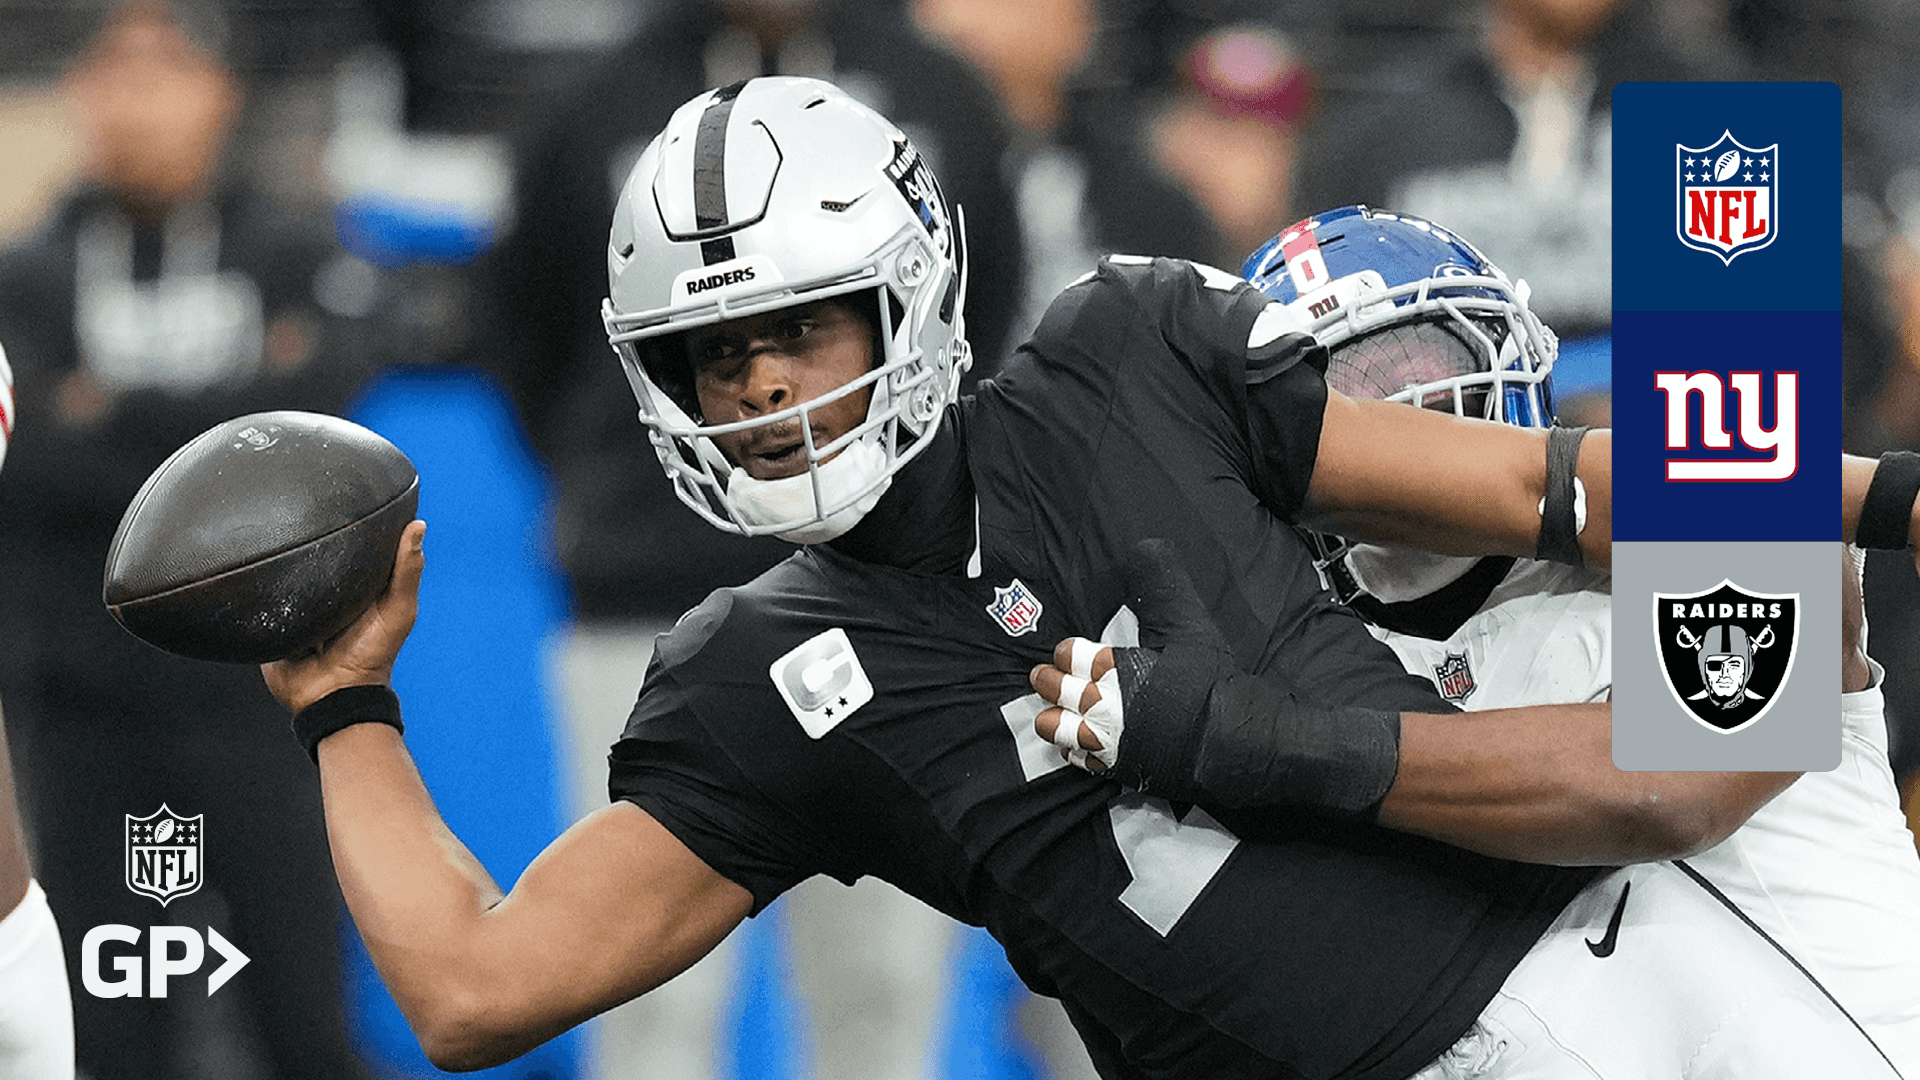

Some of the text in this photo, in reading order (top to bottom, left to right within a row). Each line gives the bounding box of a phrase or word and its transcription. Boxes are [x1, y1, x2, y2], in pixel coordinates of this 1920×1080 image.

[686, 266, 756, 296] RAIDERS
[1005, 601, 1036, 630] NFL
[782, 637, 853, 713] C
[1442, 670, 1473, 696] NFL
